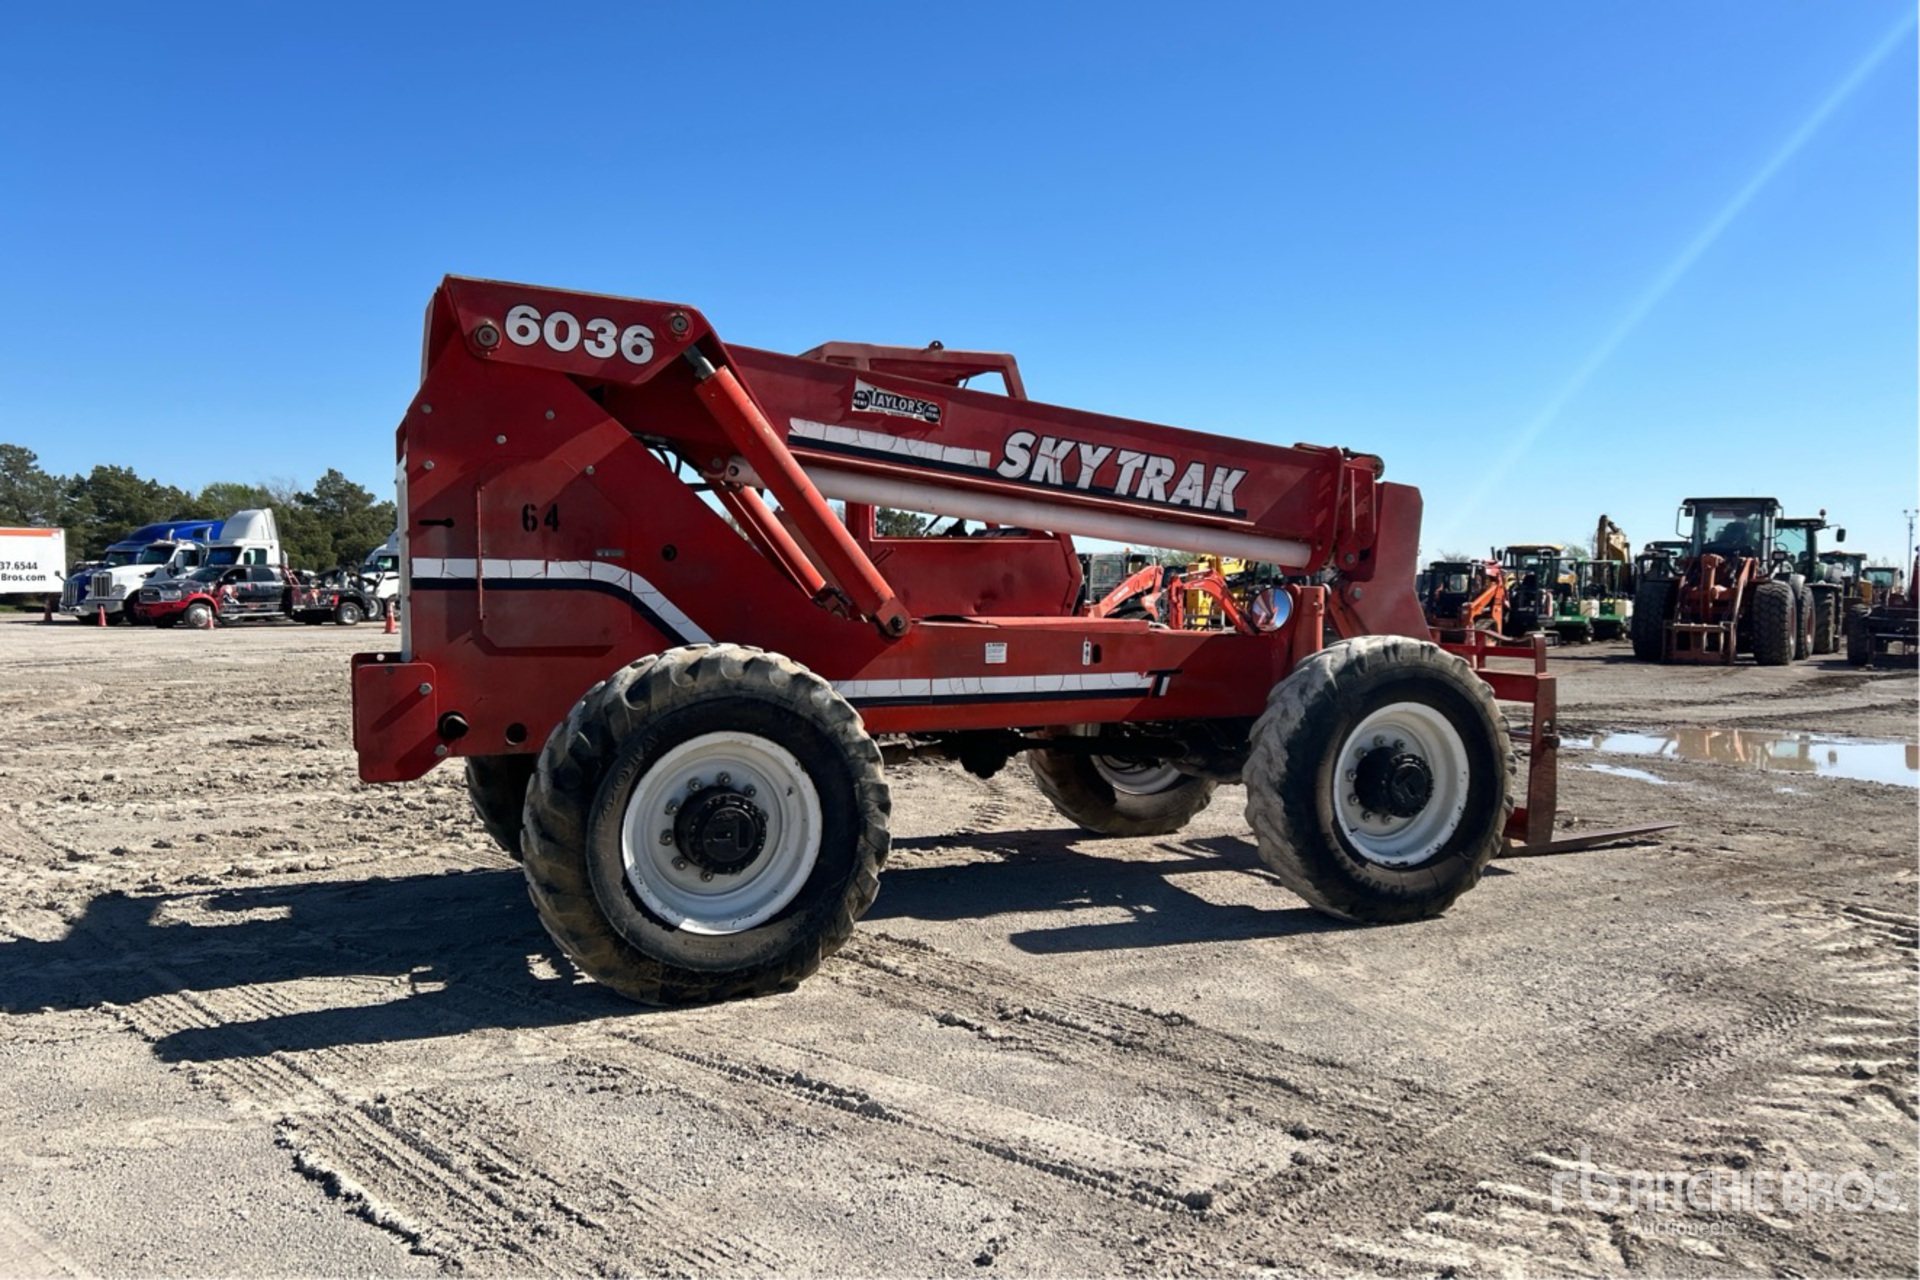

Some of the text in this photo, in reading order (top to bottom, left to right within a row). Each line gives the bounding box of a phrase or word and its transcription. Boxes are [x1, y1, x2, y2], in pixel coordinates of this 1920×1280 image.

[504, 304, 656, 365] 6036
[871, 388, 923, 413] TAYLOR'S
[996, 429, 1248, 514] SKYTRAK
[521, 503, 560, 533] 64
